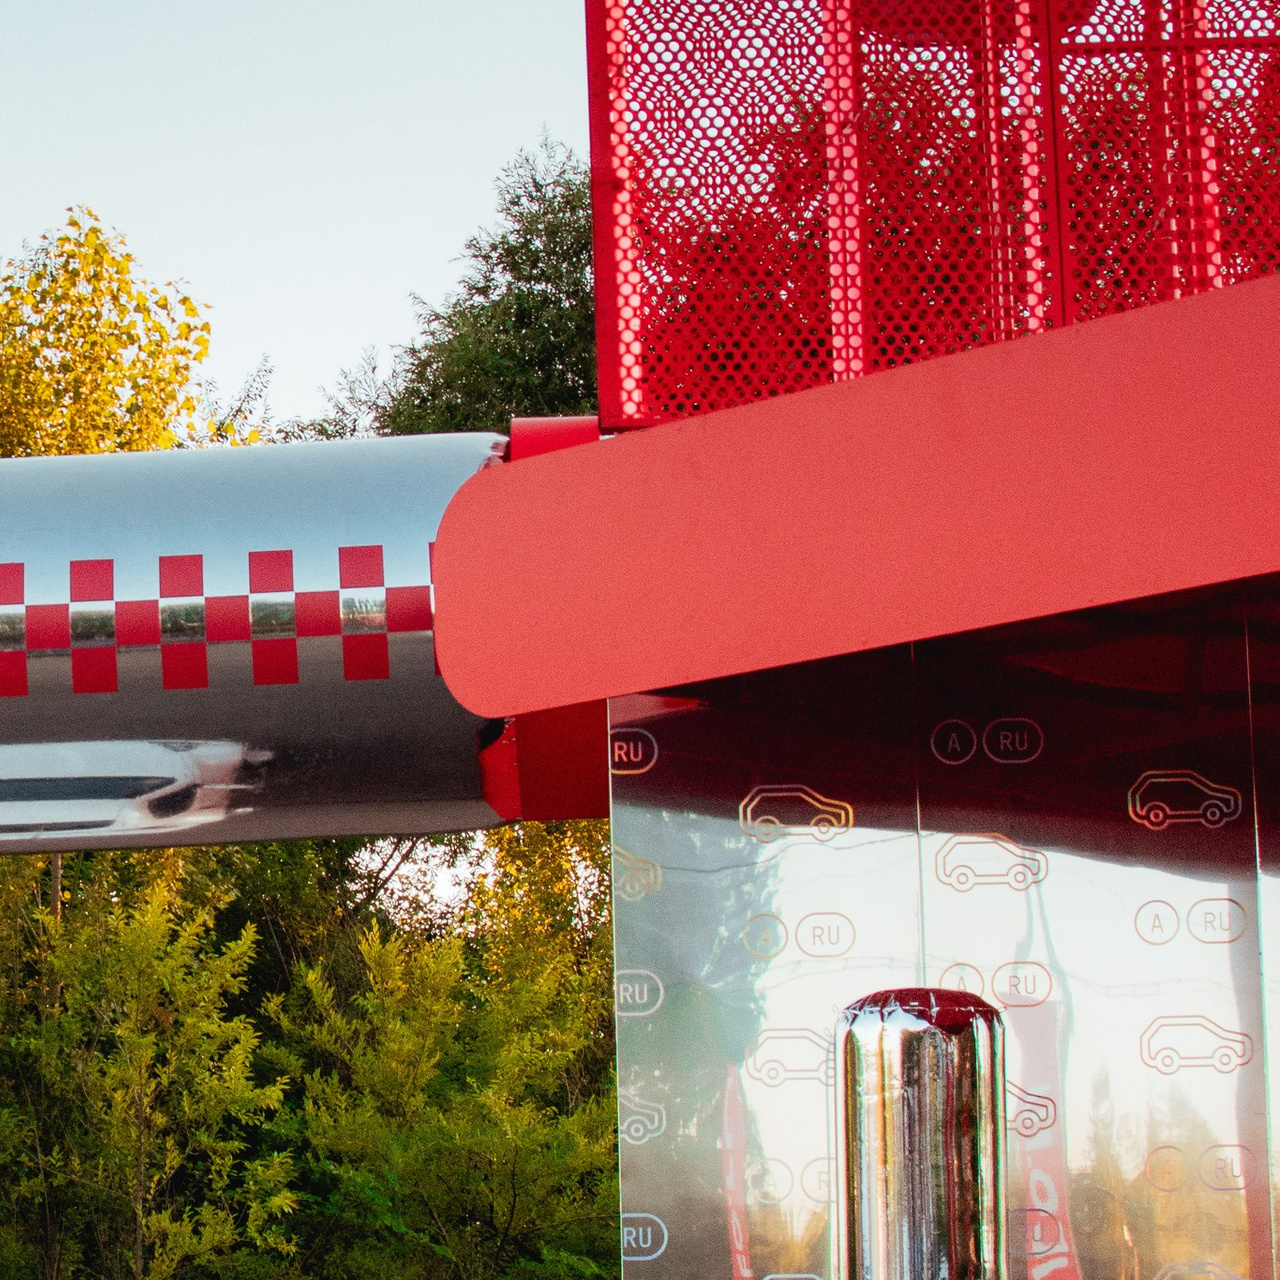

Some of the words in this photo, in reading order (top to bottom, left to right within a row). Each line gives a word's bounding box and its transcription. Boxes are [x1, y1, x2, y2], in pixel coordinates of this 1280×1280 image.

[614, 741, 643, 762] RU
[948, 732, 961, 753] A
[1000, 731, 1028, 752] RU
[1151, 912, 1164, 933] A
[1203, 911, 1231, 933] RU
[759, 926, 773, 946] A
[812, 925, 840, 946] RU
[620, 983, 648, 1004] RU
[1009, 974, 1036, 995] RU
[1214, 1158, 1243, 1179] RU
[623, 1226, 652, 1248] RU
